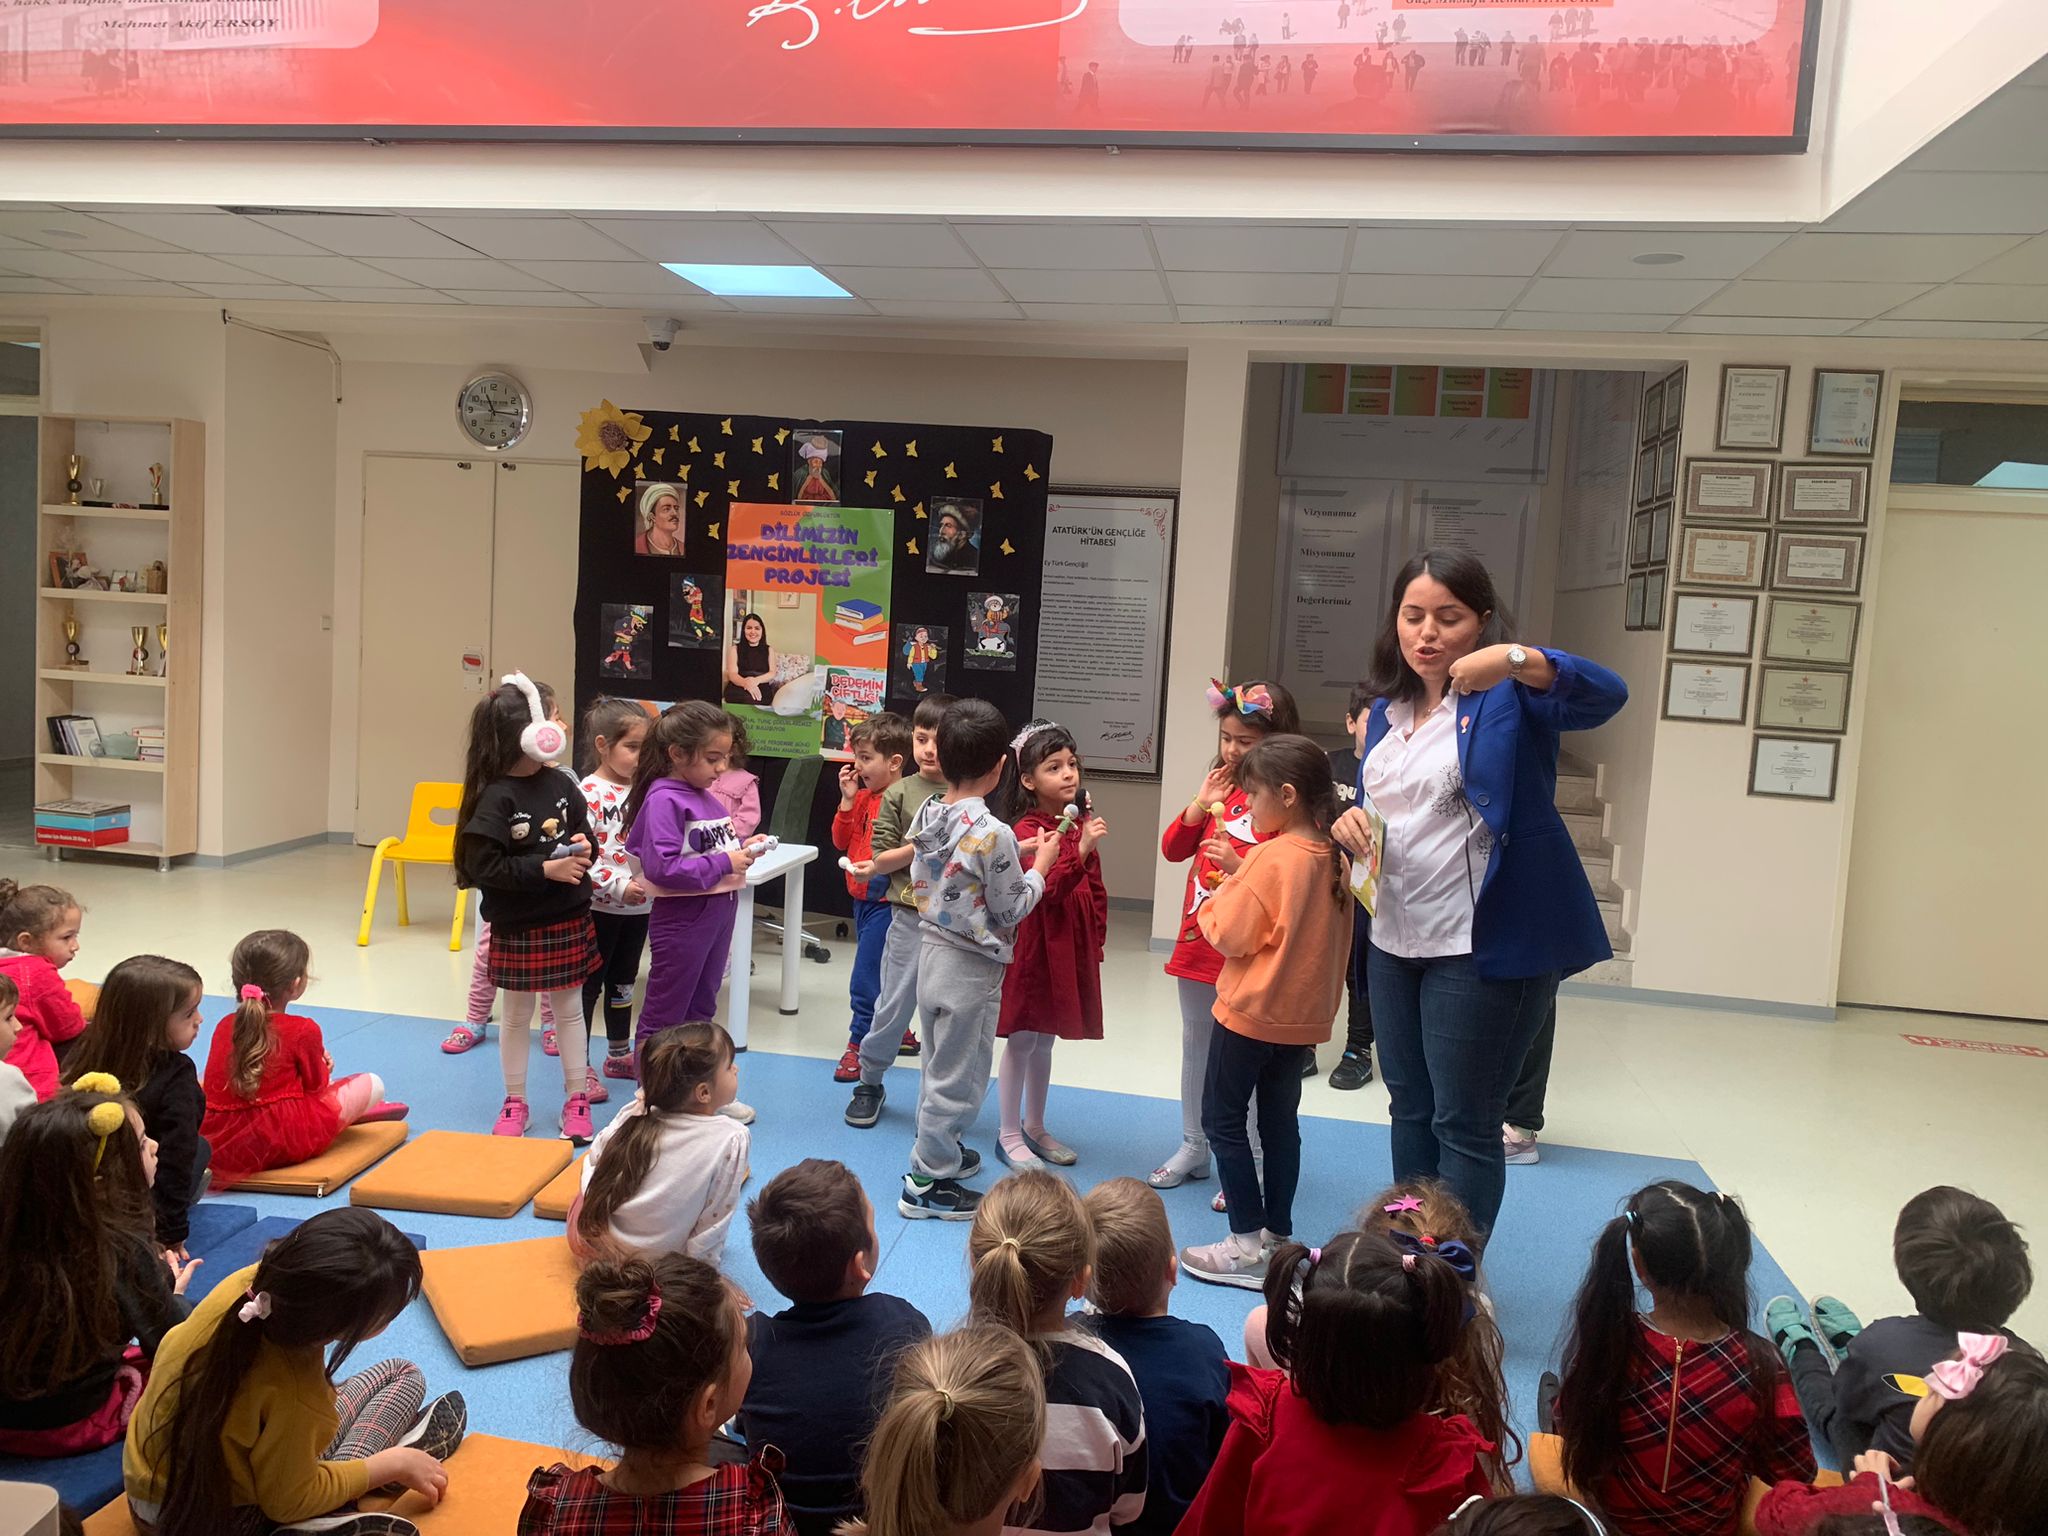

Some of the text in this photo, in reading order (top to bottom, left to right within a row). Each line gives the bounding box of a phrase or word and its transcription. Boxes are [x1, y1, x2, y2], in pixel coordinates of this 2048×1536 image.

[101, 19, 279, 30] Mehmet Akif ERSOY
[511, 397, 517, 405] 2
[490, 432, 496, 440] 6
[501, 429, 507, 437] 5
[1303, 508, 1357, 518] Vizyonumuz
[760, 522, 859, 545] DİLİMİZİN
[1052, 525, 1147, 538] ATATÜRK'ÜN GENÇLİĞE
[1080, 536, 1116, 547] HİTABESİ
[1300, 548, 1356, 558] Misyonumuz
[764, 567, 852, 587] PROJESİ
[1296, 595, 1352, 606] Değerlerimiz
[831, 674, 884, 692] DEDEMİN
